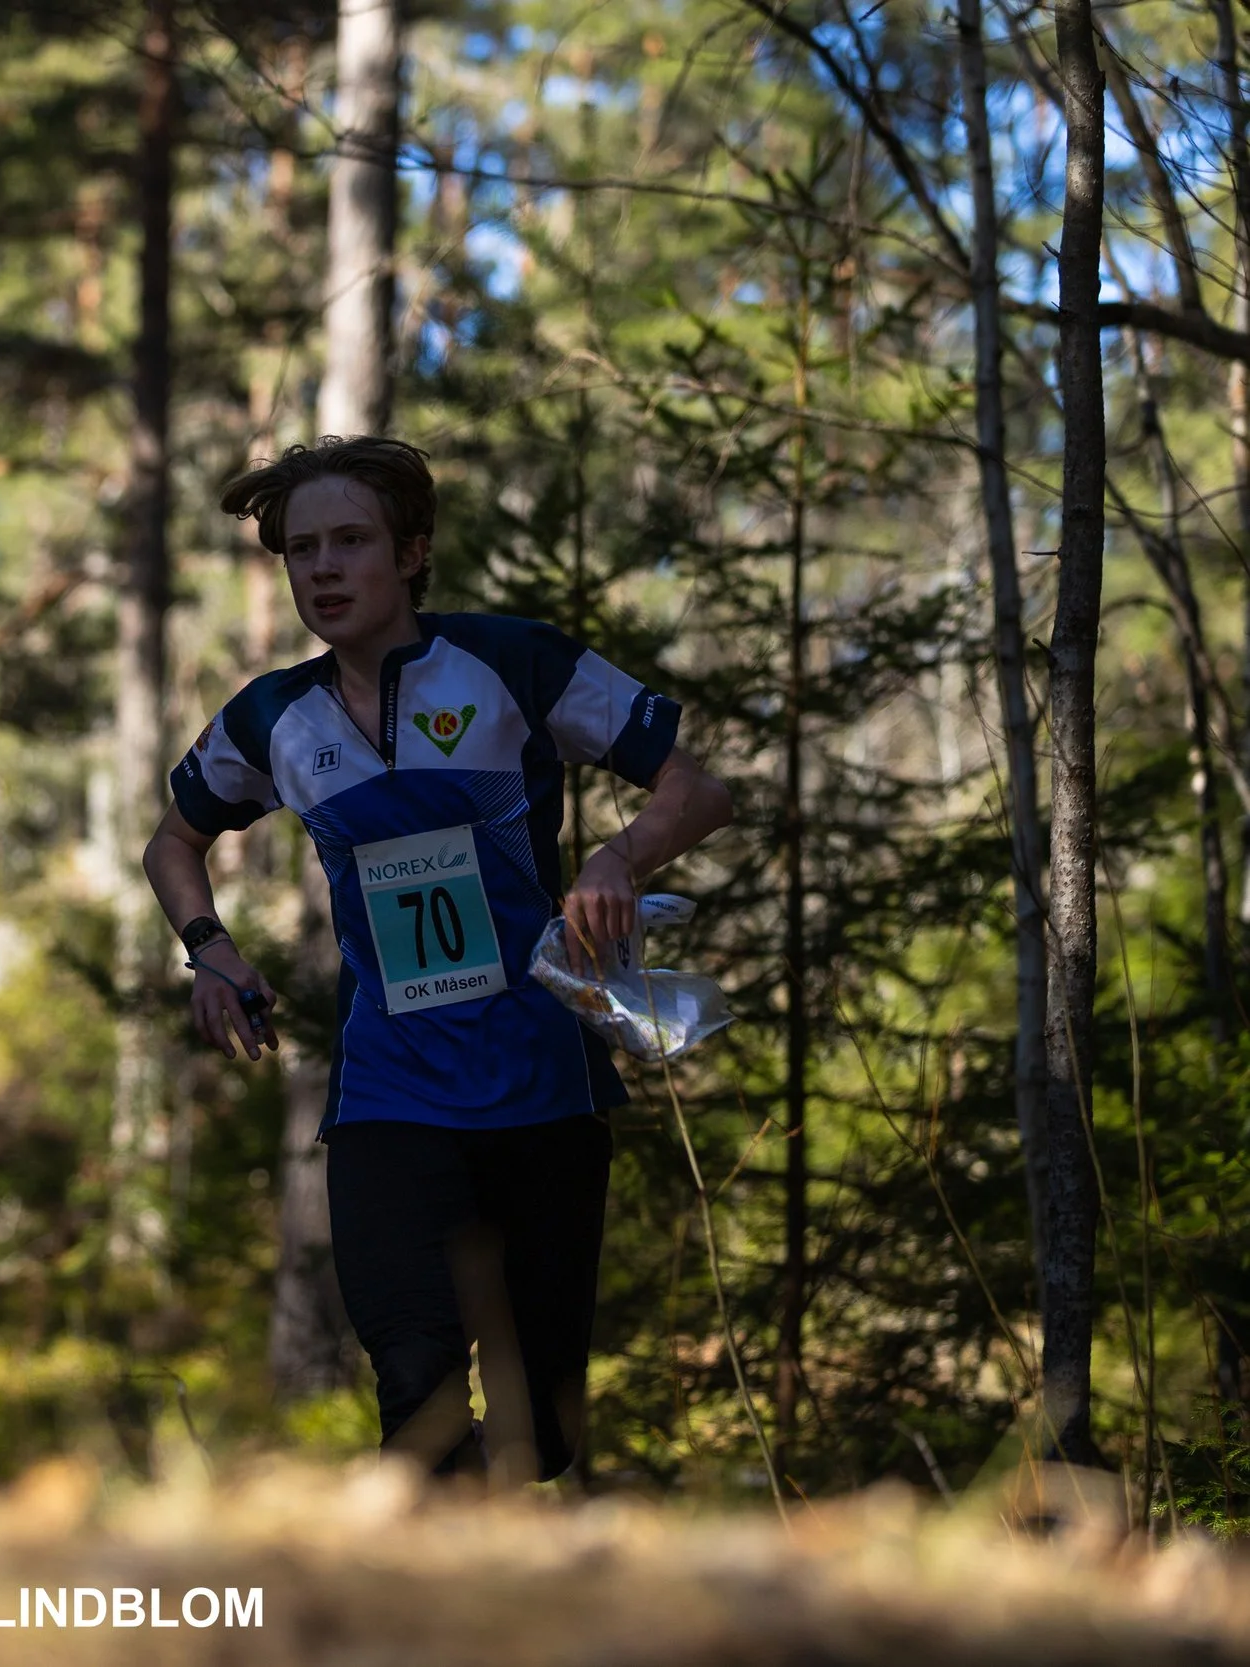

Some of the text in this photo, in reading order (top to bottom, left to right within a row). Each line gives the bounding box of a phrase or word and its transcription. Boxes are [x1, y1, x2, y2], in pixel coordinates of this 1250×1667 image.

[368, 856, 437, 882] NOREX
[397, 886, 466, 970] 70
[405, 974, 489, 1000] OK Måsen
